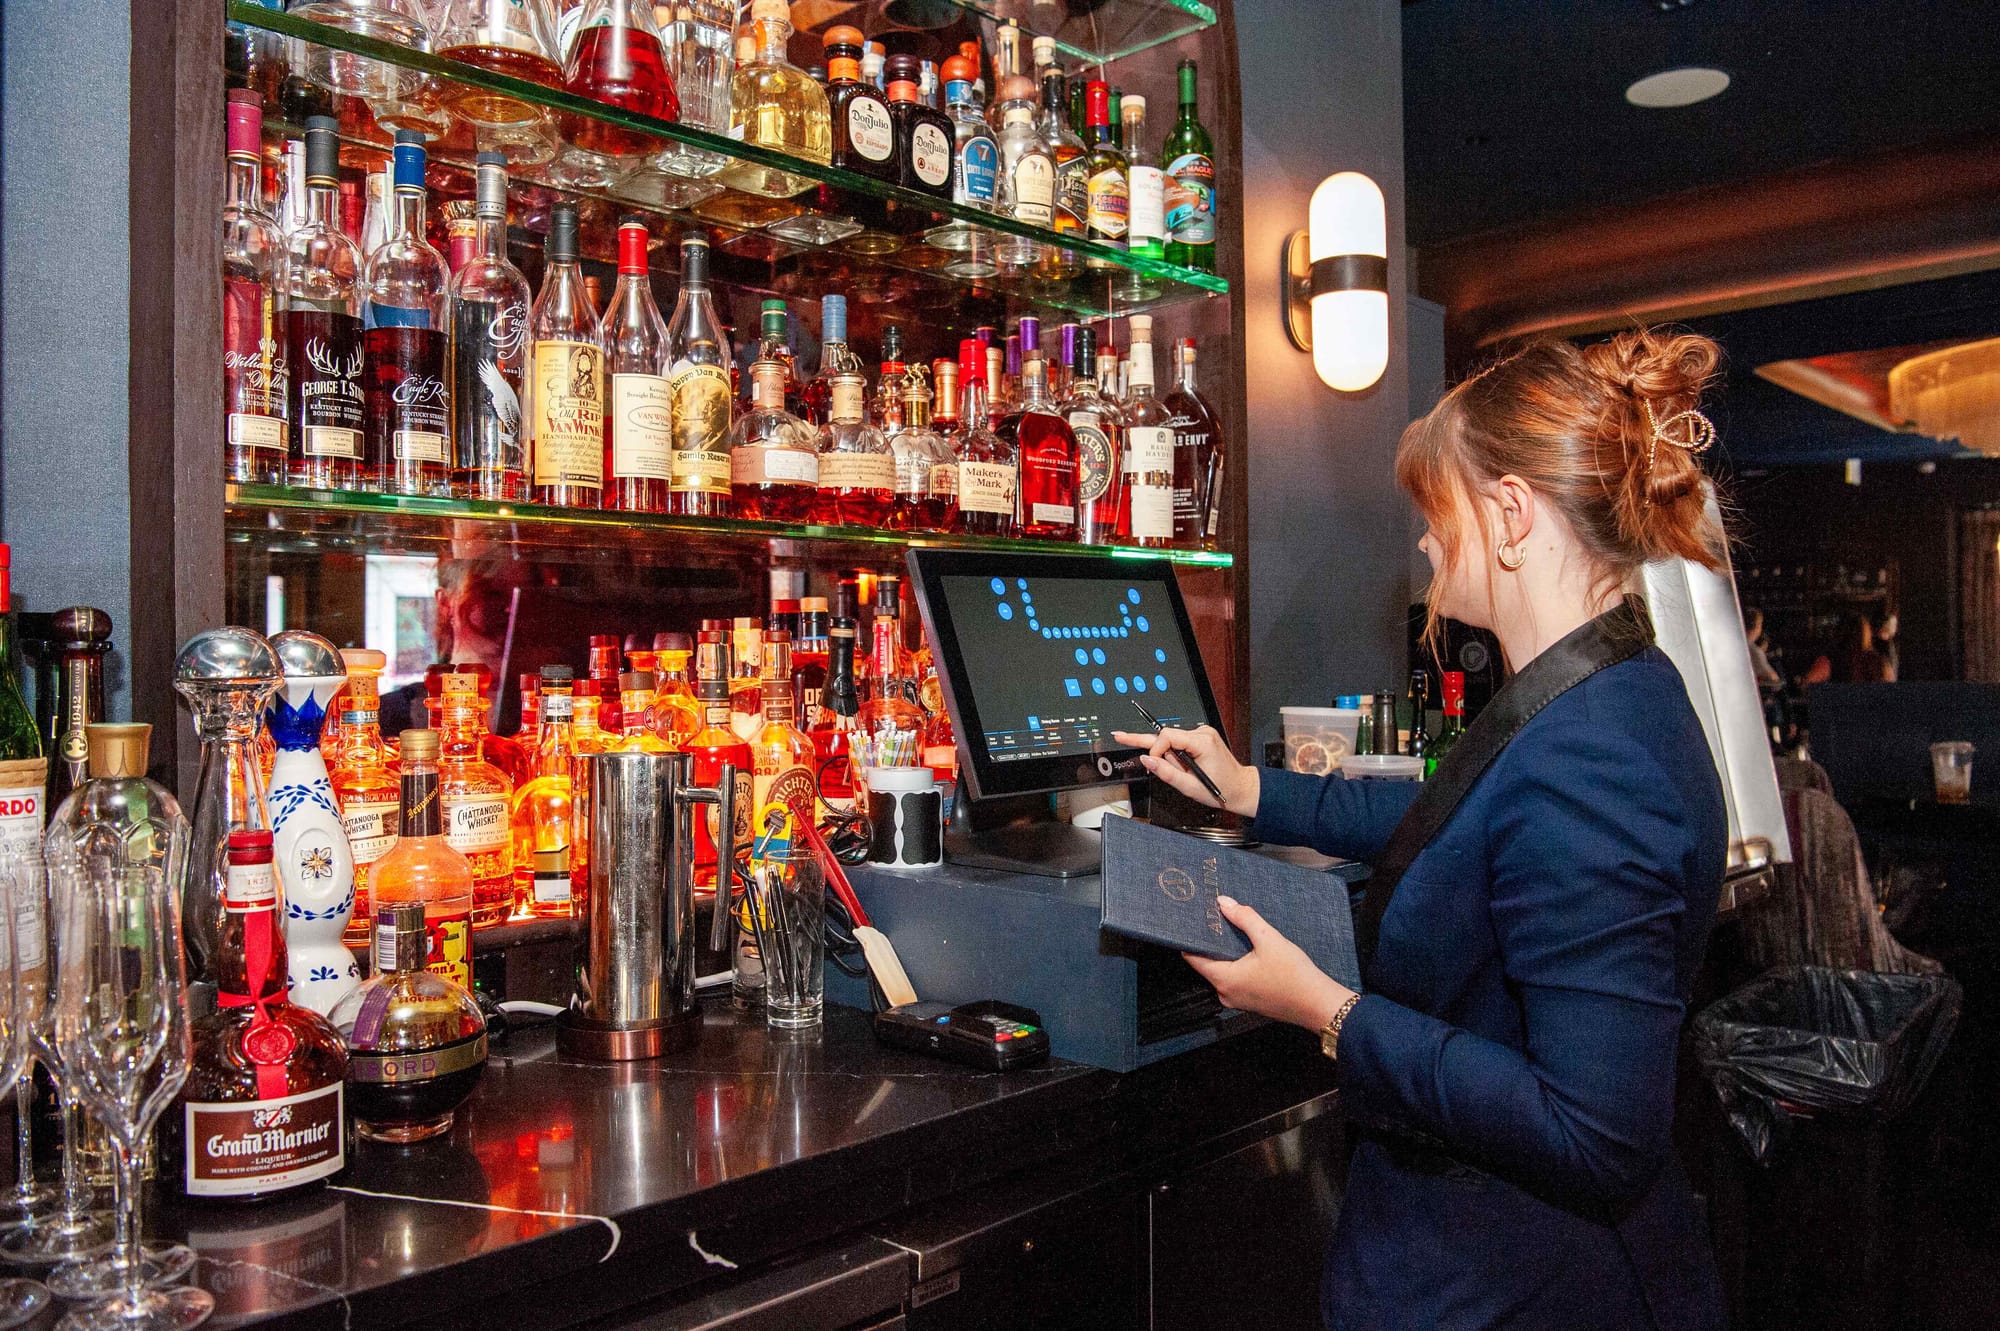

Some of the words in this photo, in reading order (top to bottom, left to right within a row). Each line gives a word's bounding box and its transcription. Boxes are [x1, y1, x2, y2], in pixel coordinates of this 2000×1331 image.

[851, 109, 869, 123] Don
[868, 114, 889, 130] Julio
[916, 136, 931, 148] Don
[930, 140, 948, 155] Julio
[671, 369, 694, 391] Pappy
[695, 368, 713, 377] Van
[302, 380, 334, 398] GEORGE
[392, 374, 434, 405] Eagle
[309, 403, 342, 412] KENTUCKY
[312, 410, 342, 418] BOURBON
[559, 409, 576, 419] Old
[577, 408, 601, 421] RIP
[547, 417, 572, 433] VAN
[1185, 433, 1206, 446] ENVY
[677, 451, 705, 462] Family
[966, 466, 1003, 479] Maker's
[976, 477, 1002, 489] Mark
[71, 695, 82, 726] 1942
[1113, 760, 1135, 770] SpotOn
[364, 790, 399, 802] BOWMAN
[457, 803, 504, 826] CHATTANOOGA
[467, 814, 499, 831] WHISKEY
[206, 1132, 262, 1158] Grand
[261, 1120, 332, 1153] Marnier
[245, 1164, 272, 1172] COGNAC
[284, 1157, 308, 1168] ORANGE
[255, 1153, 293, 1165] LIQUEUR
[258, 1175, 289, 1185] PARIS
